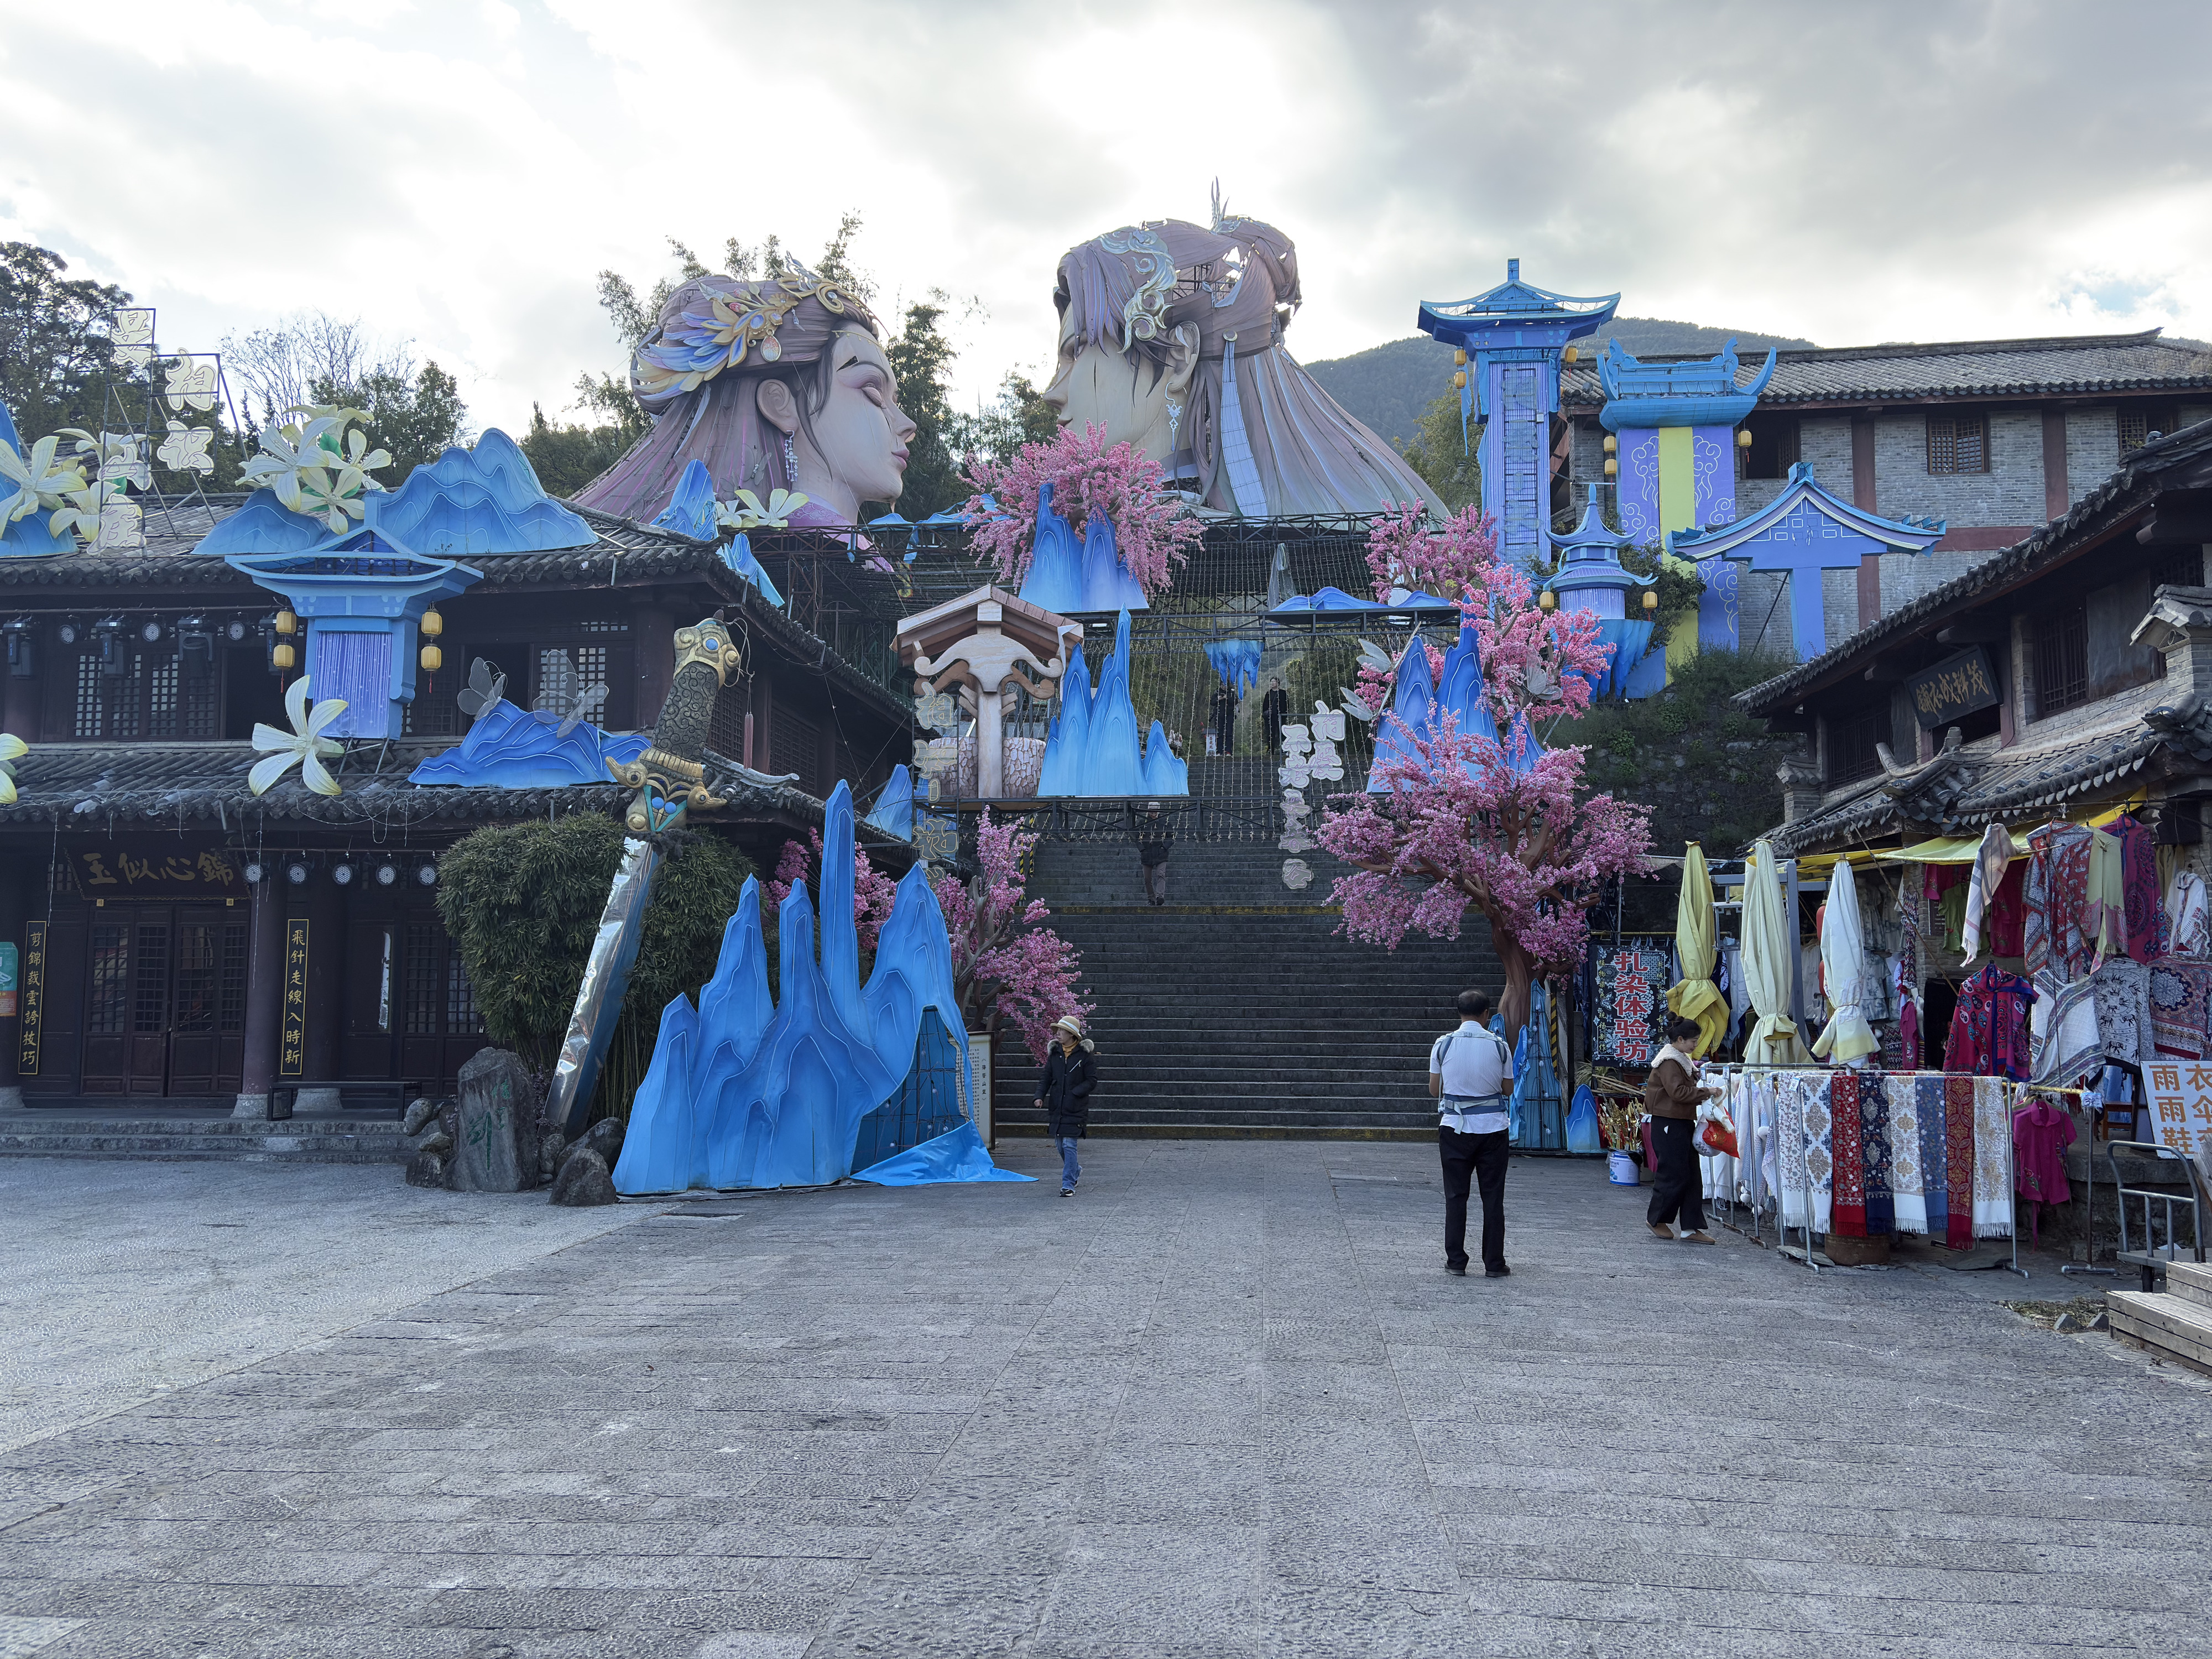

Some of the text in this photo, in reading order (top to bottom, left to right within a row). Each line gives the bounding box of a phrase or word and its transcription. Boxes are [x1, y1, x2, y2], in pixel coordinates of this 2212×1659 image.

[1614, 951, 1650, 1061] 扎染体验坊
